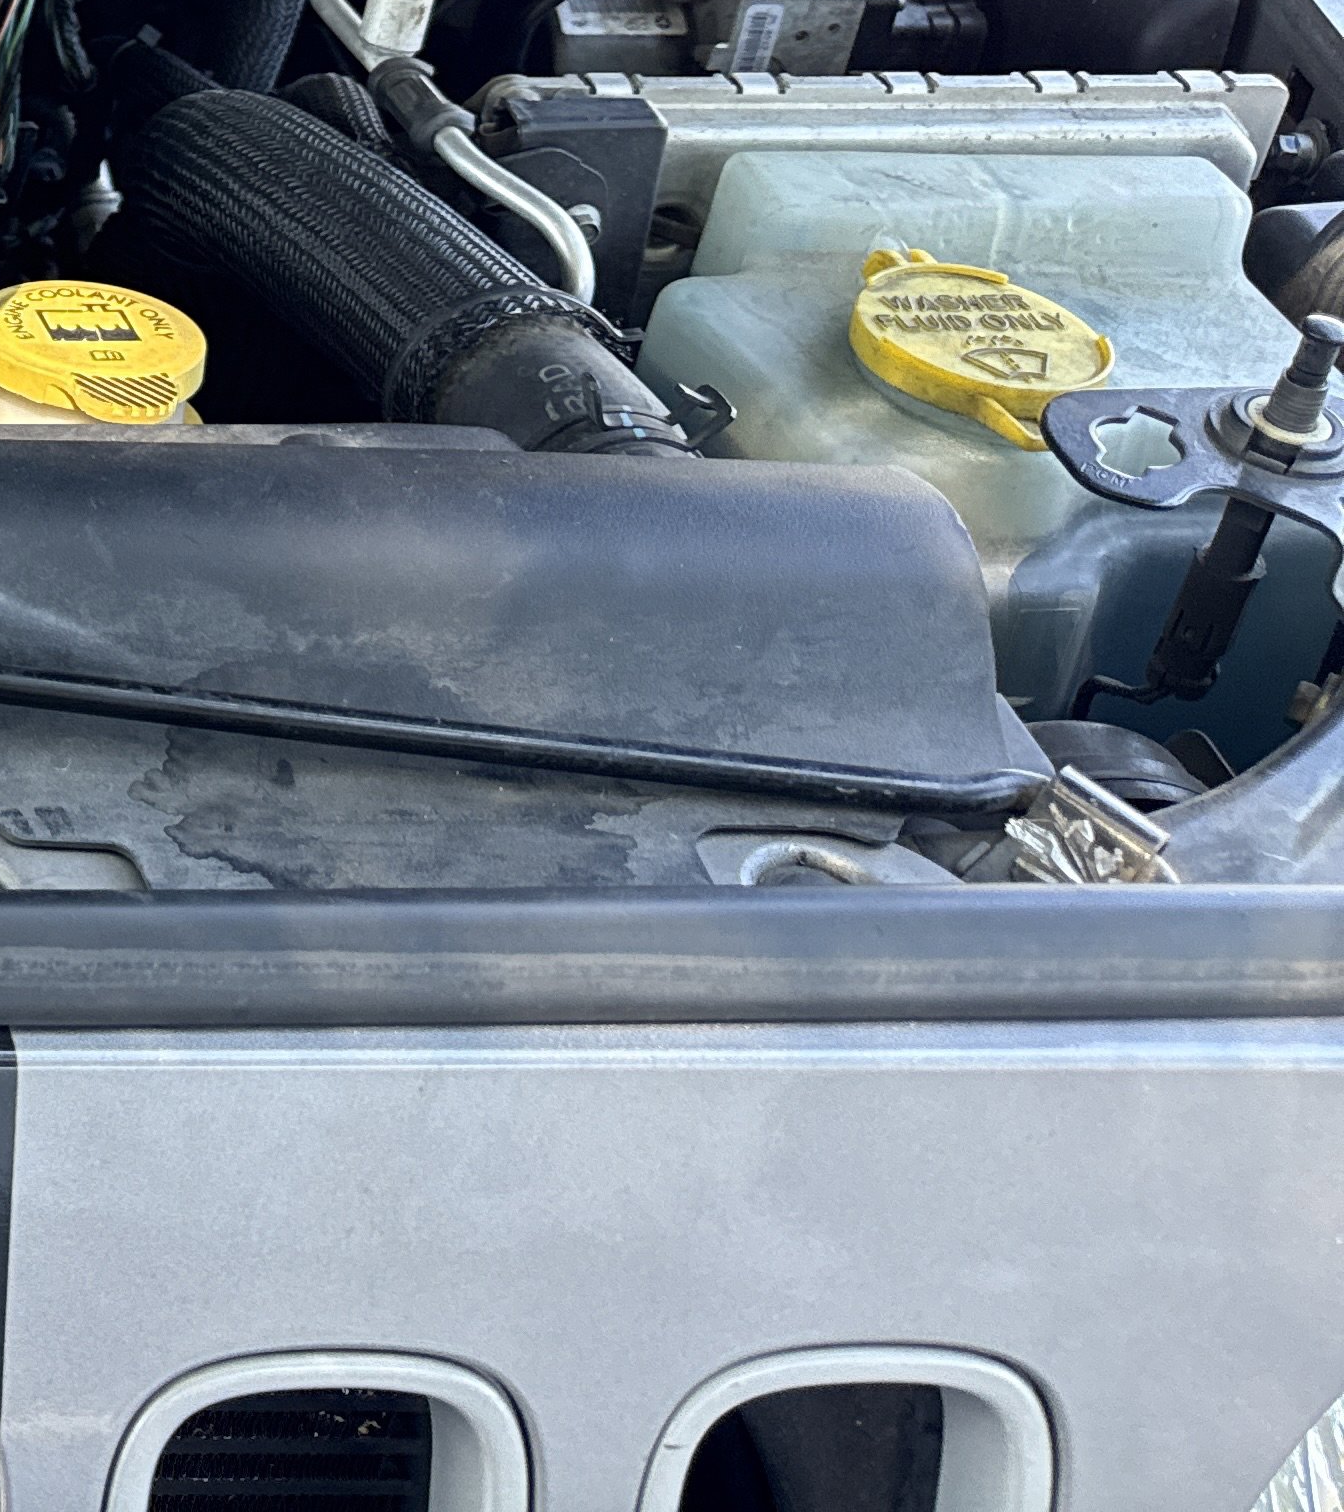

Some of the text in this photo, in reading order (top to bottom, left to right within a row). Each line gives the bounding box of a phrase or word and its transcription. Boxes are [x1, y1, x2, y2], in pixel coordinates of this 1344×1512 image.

[878, 293, 1031, 312] WASHER
[4, 288, 175, 340] ENGINE COOLANT ONLY
[873, 311, 1067, 333] FLUID ONLY
